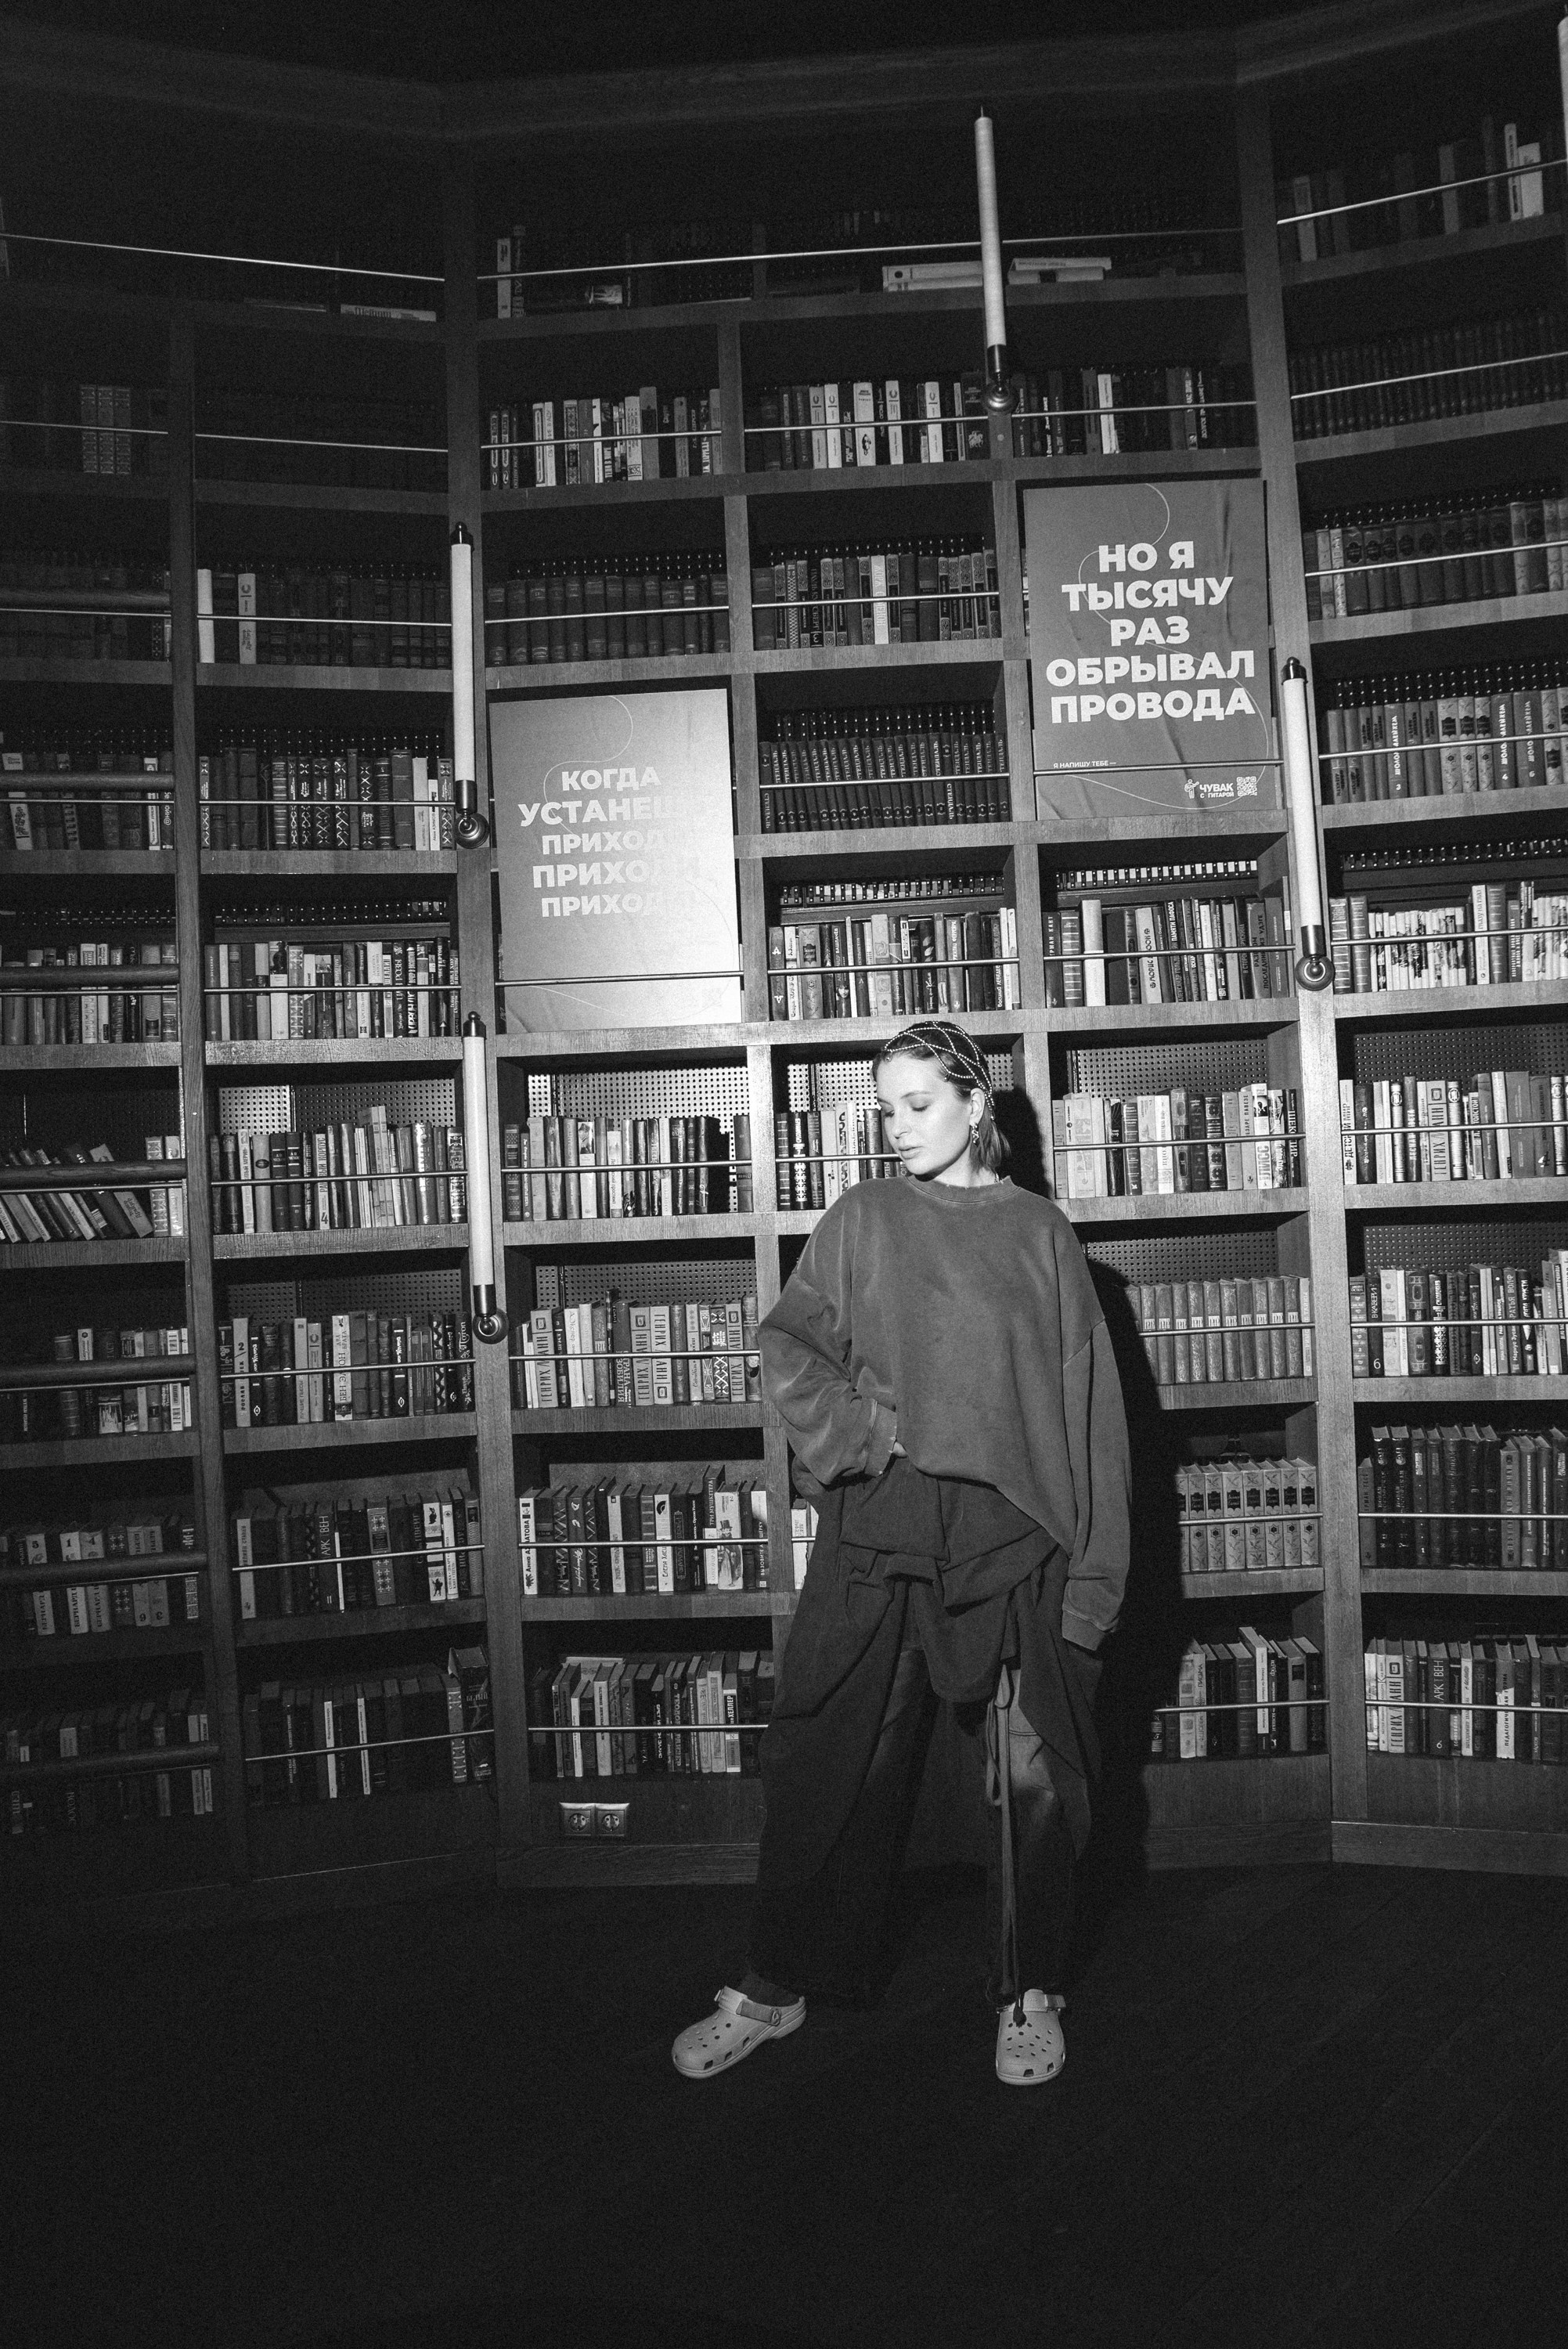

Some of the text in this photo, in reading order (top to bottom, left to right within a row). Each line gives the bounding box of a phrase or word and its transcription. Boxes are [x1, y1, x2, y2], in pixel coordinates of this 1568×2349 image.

[1098, 540, 1195, 572] НО Я
[1062, 576, 1234, 612] ТЫСЯЧУ
[1110, 615, 1190, 647] РАЗ
[1046, 650, 1255, 687] ОБРЫВАЛ
[1051, 687, 1256, 723] ПРОВОДА
[561, 767, 661, 791] КОГДА
[782, 749, 791, 783] ТЕНДАЛЬ
[811, 749, 822, 781] ТЕНДАЛЬ
[822, 748, 832, 781] ТЕНДАЛЬ
[1199, 783, 1234, 792] ЧУВАК
[1170, 921, 1178, 942] ПАМЯТИ
[1260, 951, 1269, 989] ПОСЛЕДНИ
[316, 1138, 327, 1193] РАКВЫЙ КОРПУС
[1433, 1142, 1447, 1175] ГЕНРИХ
[320, 1212, 328, 1225] 4
[654, 1314, 667, 1346] ГЕНРИХ
[238, 1342, 244, 1351] 2
[1373, 1358, 1381, 1369] 6
[539, 1370, 552, 1402] ГЕНРИХ
[636, 1366, 650, 1400] ГЕНРИХ
[730, 1364, 744, 1396] ГЕНРИХ
[321, 1539, 330, 1555] АРК
[1433, 1683, 1444, 1701] АРК
[1390, 1715, 1403, 1747] ГЕНРИХ
[1436, 1740, 1443, 1748] 6
